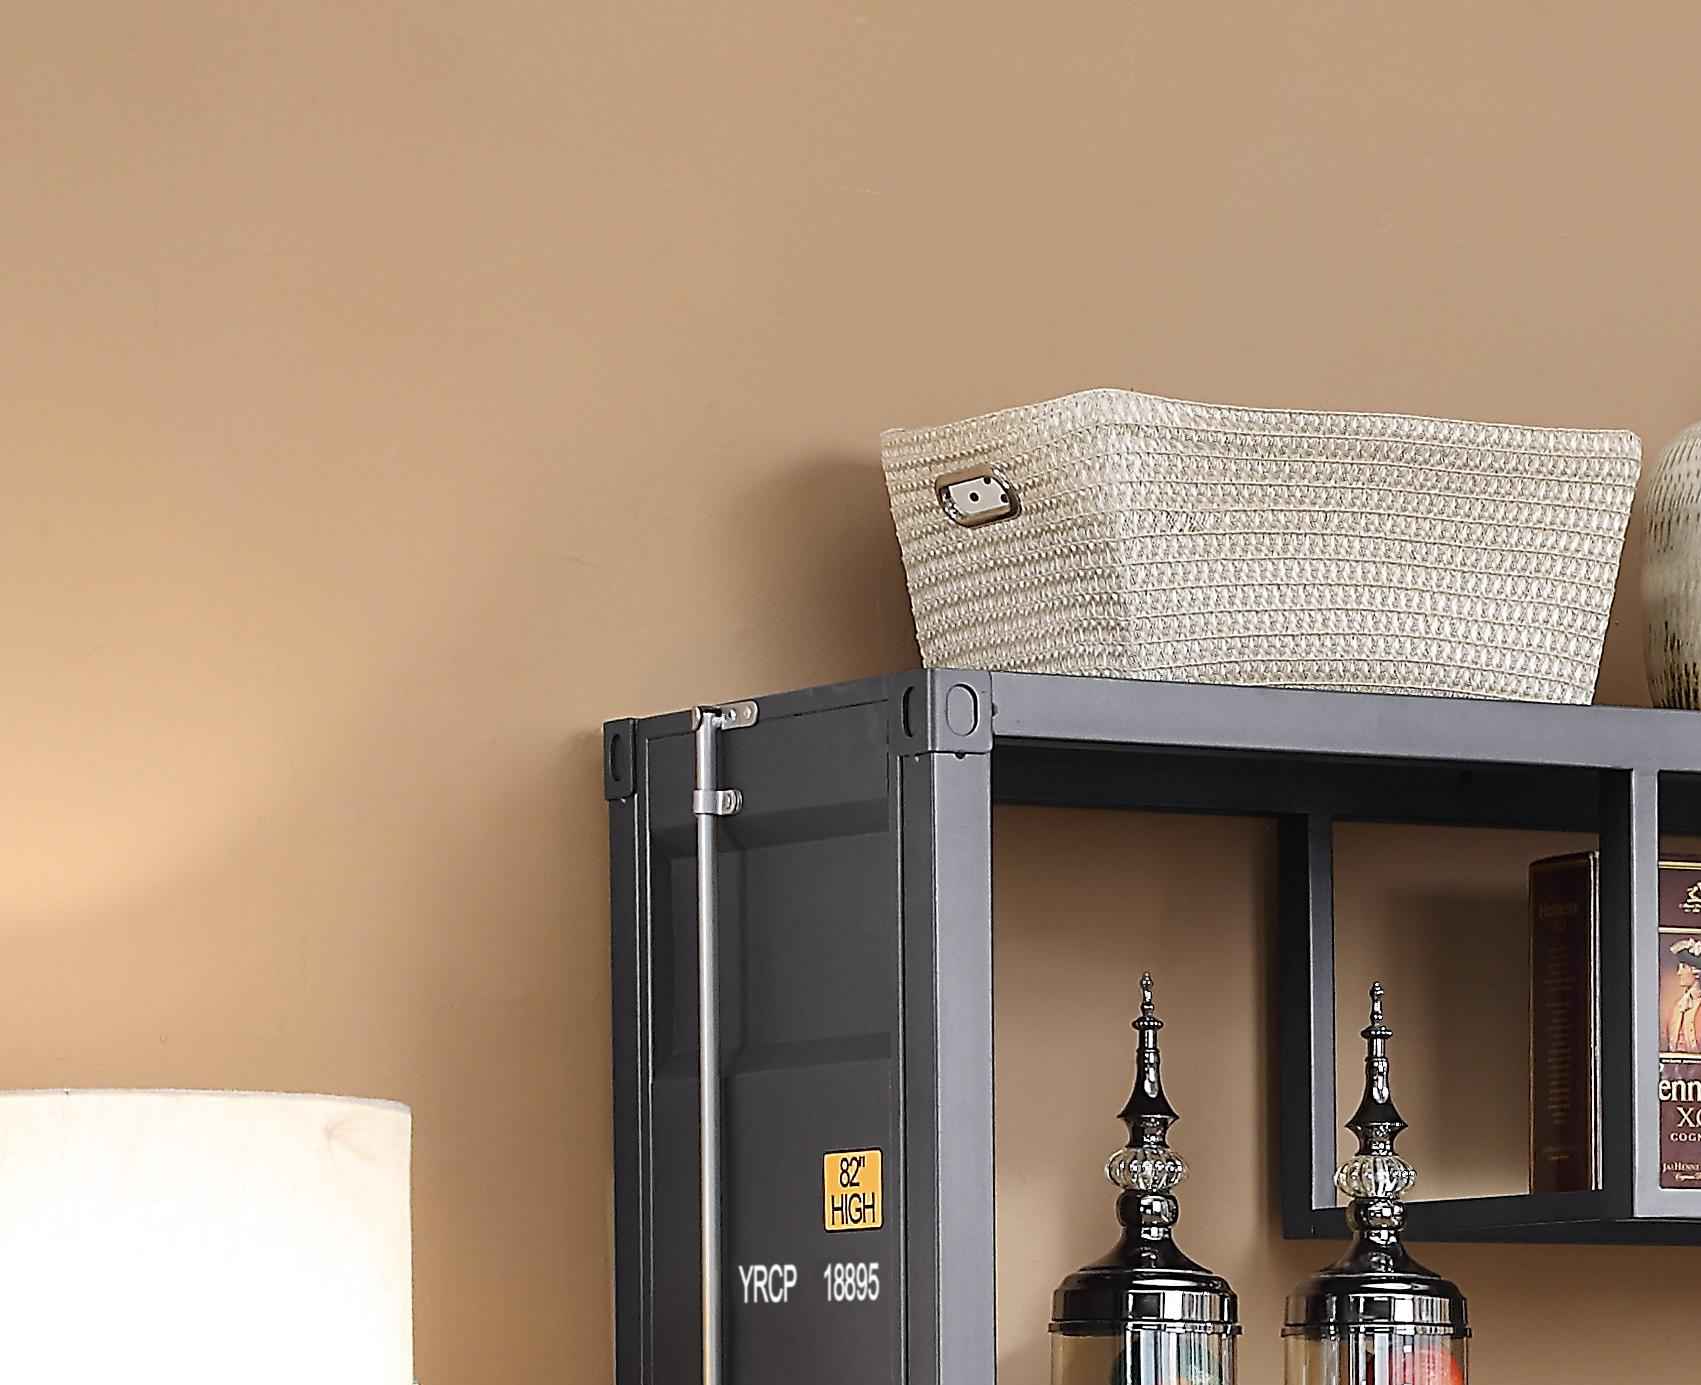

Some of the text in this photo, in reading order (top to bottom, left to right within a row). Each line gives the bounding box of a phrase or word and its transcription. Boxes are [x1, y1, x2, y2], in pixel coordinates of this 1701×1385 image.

[831, 1193, 875, 1226] HIGH
[738, 1262, 880, 1304] YRCP 18895
